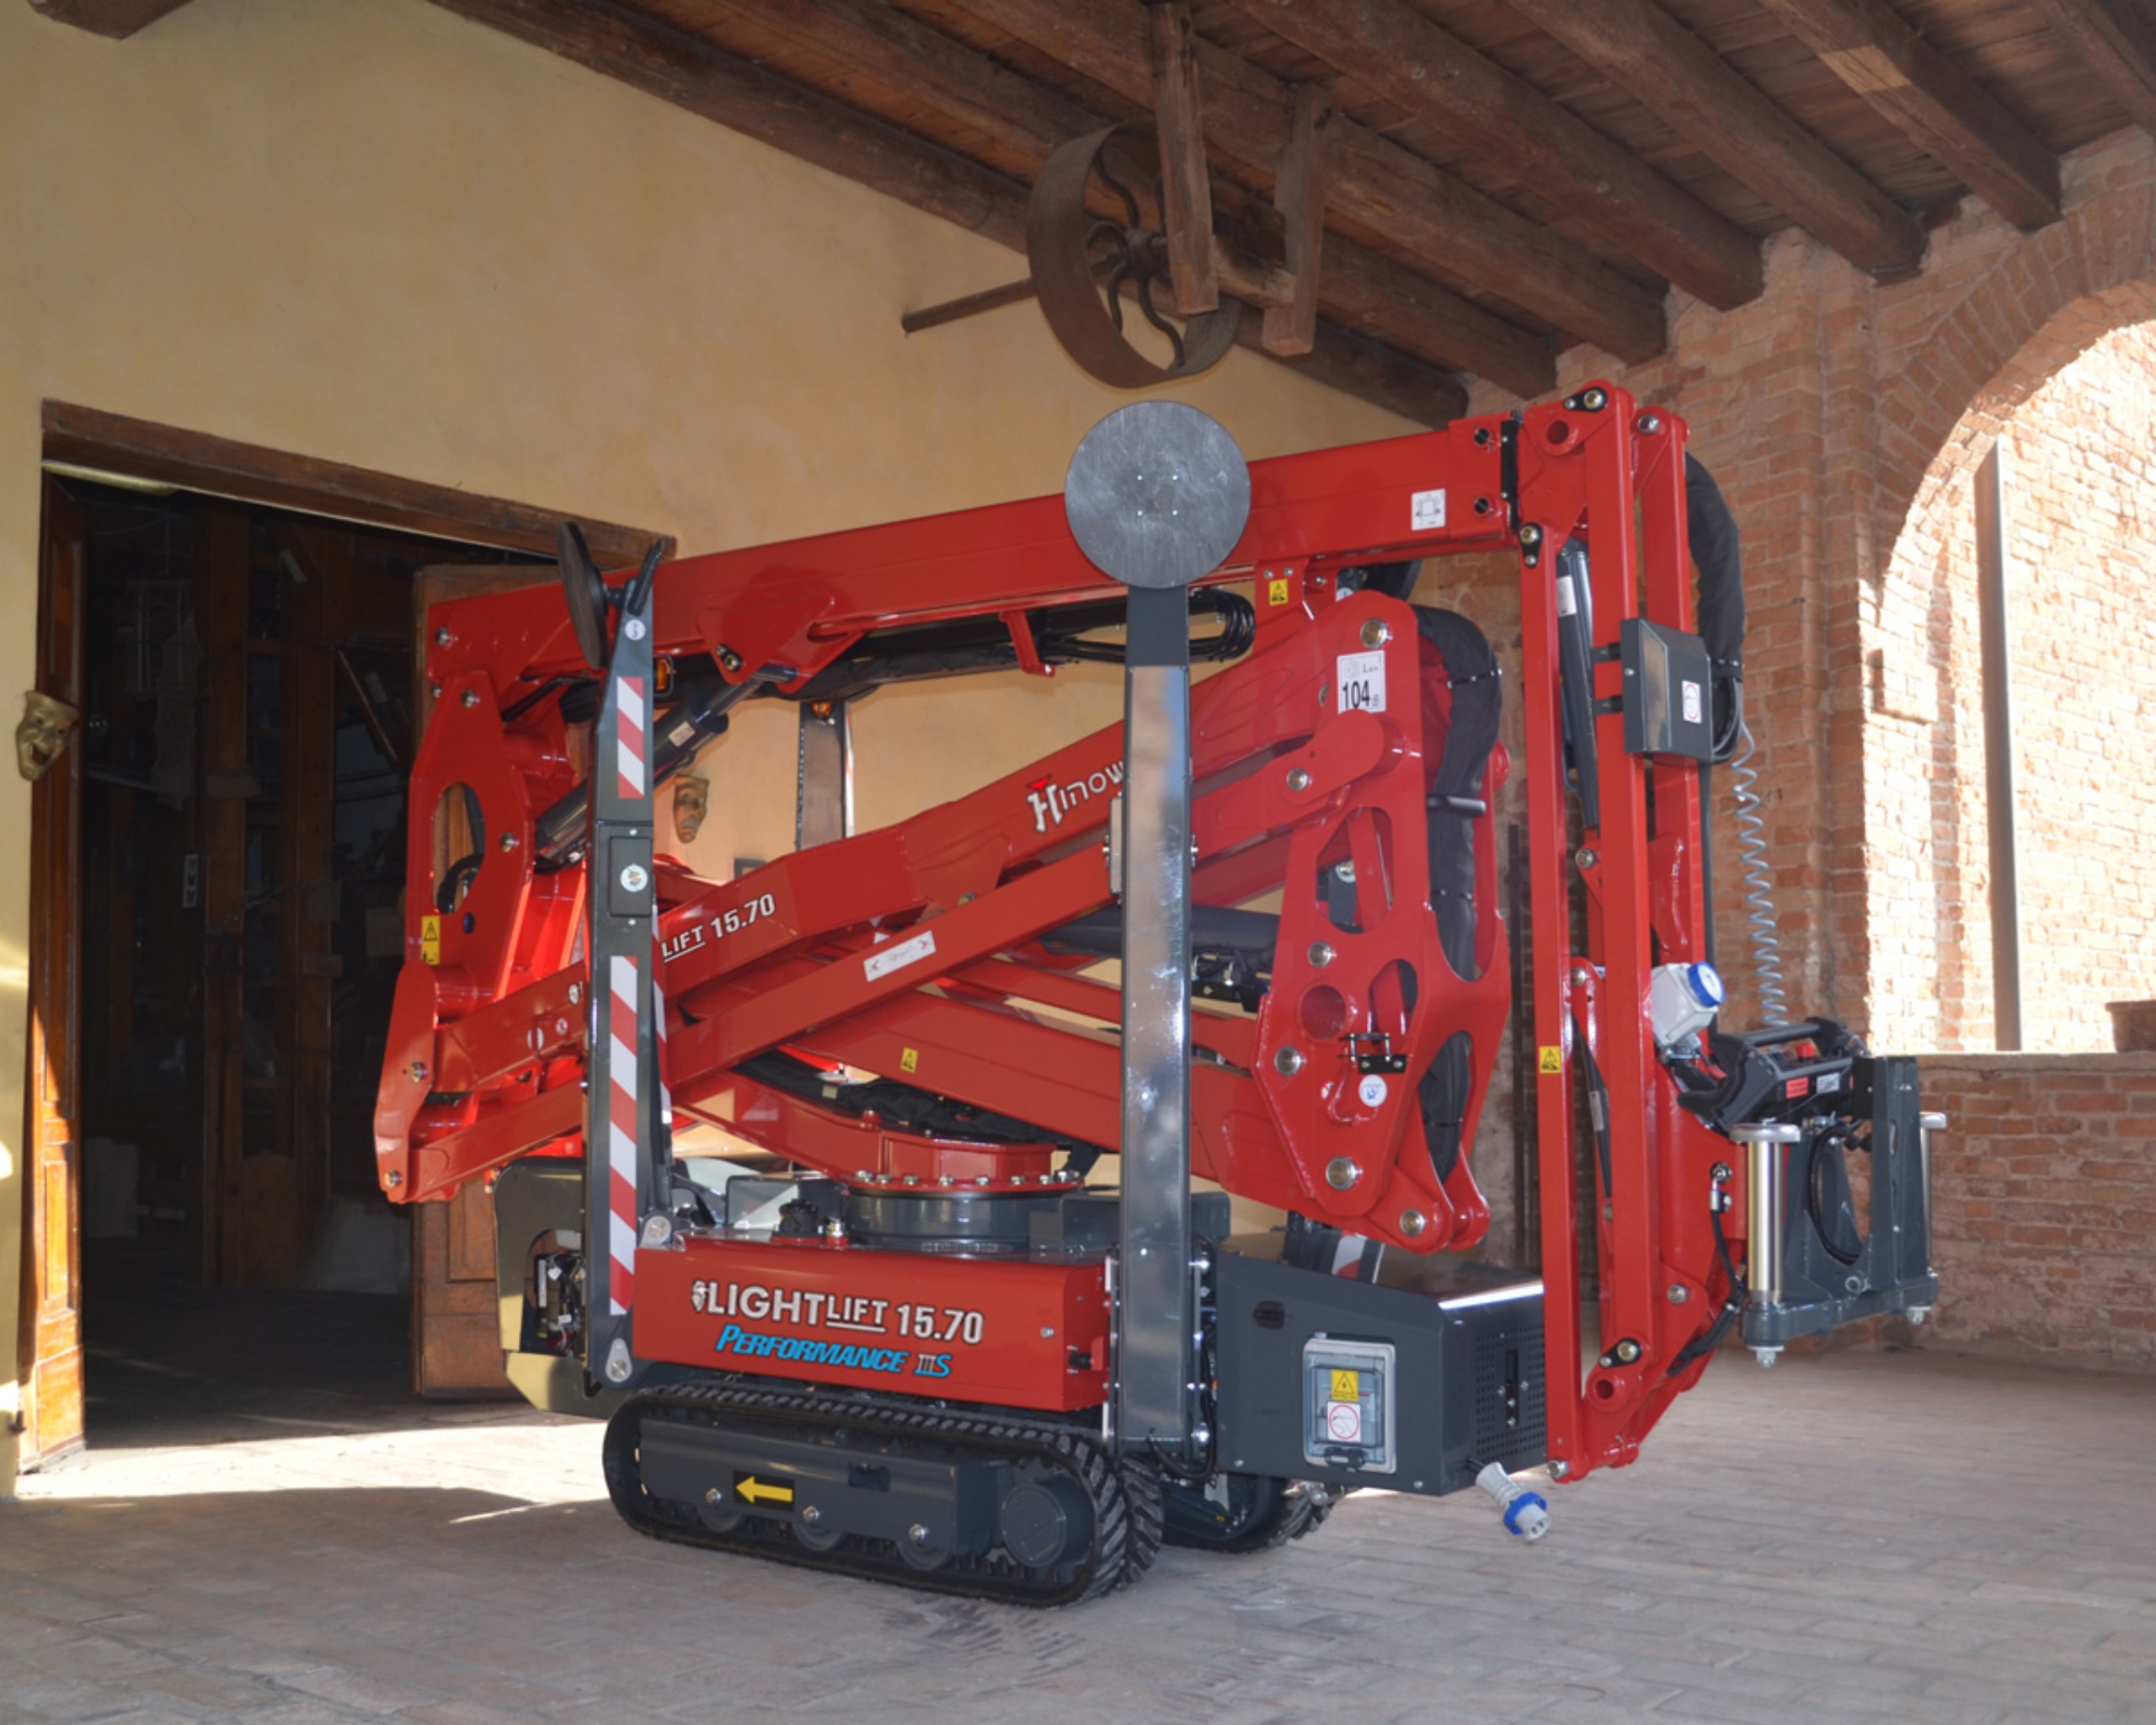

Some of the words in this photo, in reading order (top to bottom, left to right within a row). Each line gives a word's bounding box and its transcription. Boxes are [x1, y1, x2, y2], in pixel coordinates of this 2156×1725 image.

[1342, 680, 1370, 709] 104
[710, 893, 776, 939] 15.70
[896, 1303, 985, 1344] 15.70
[715, 1323, 910, 1374] PERFORMANCE
